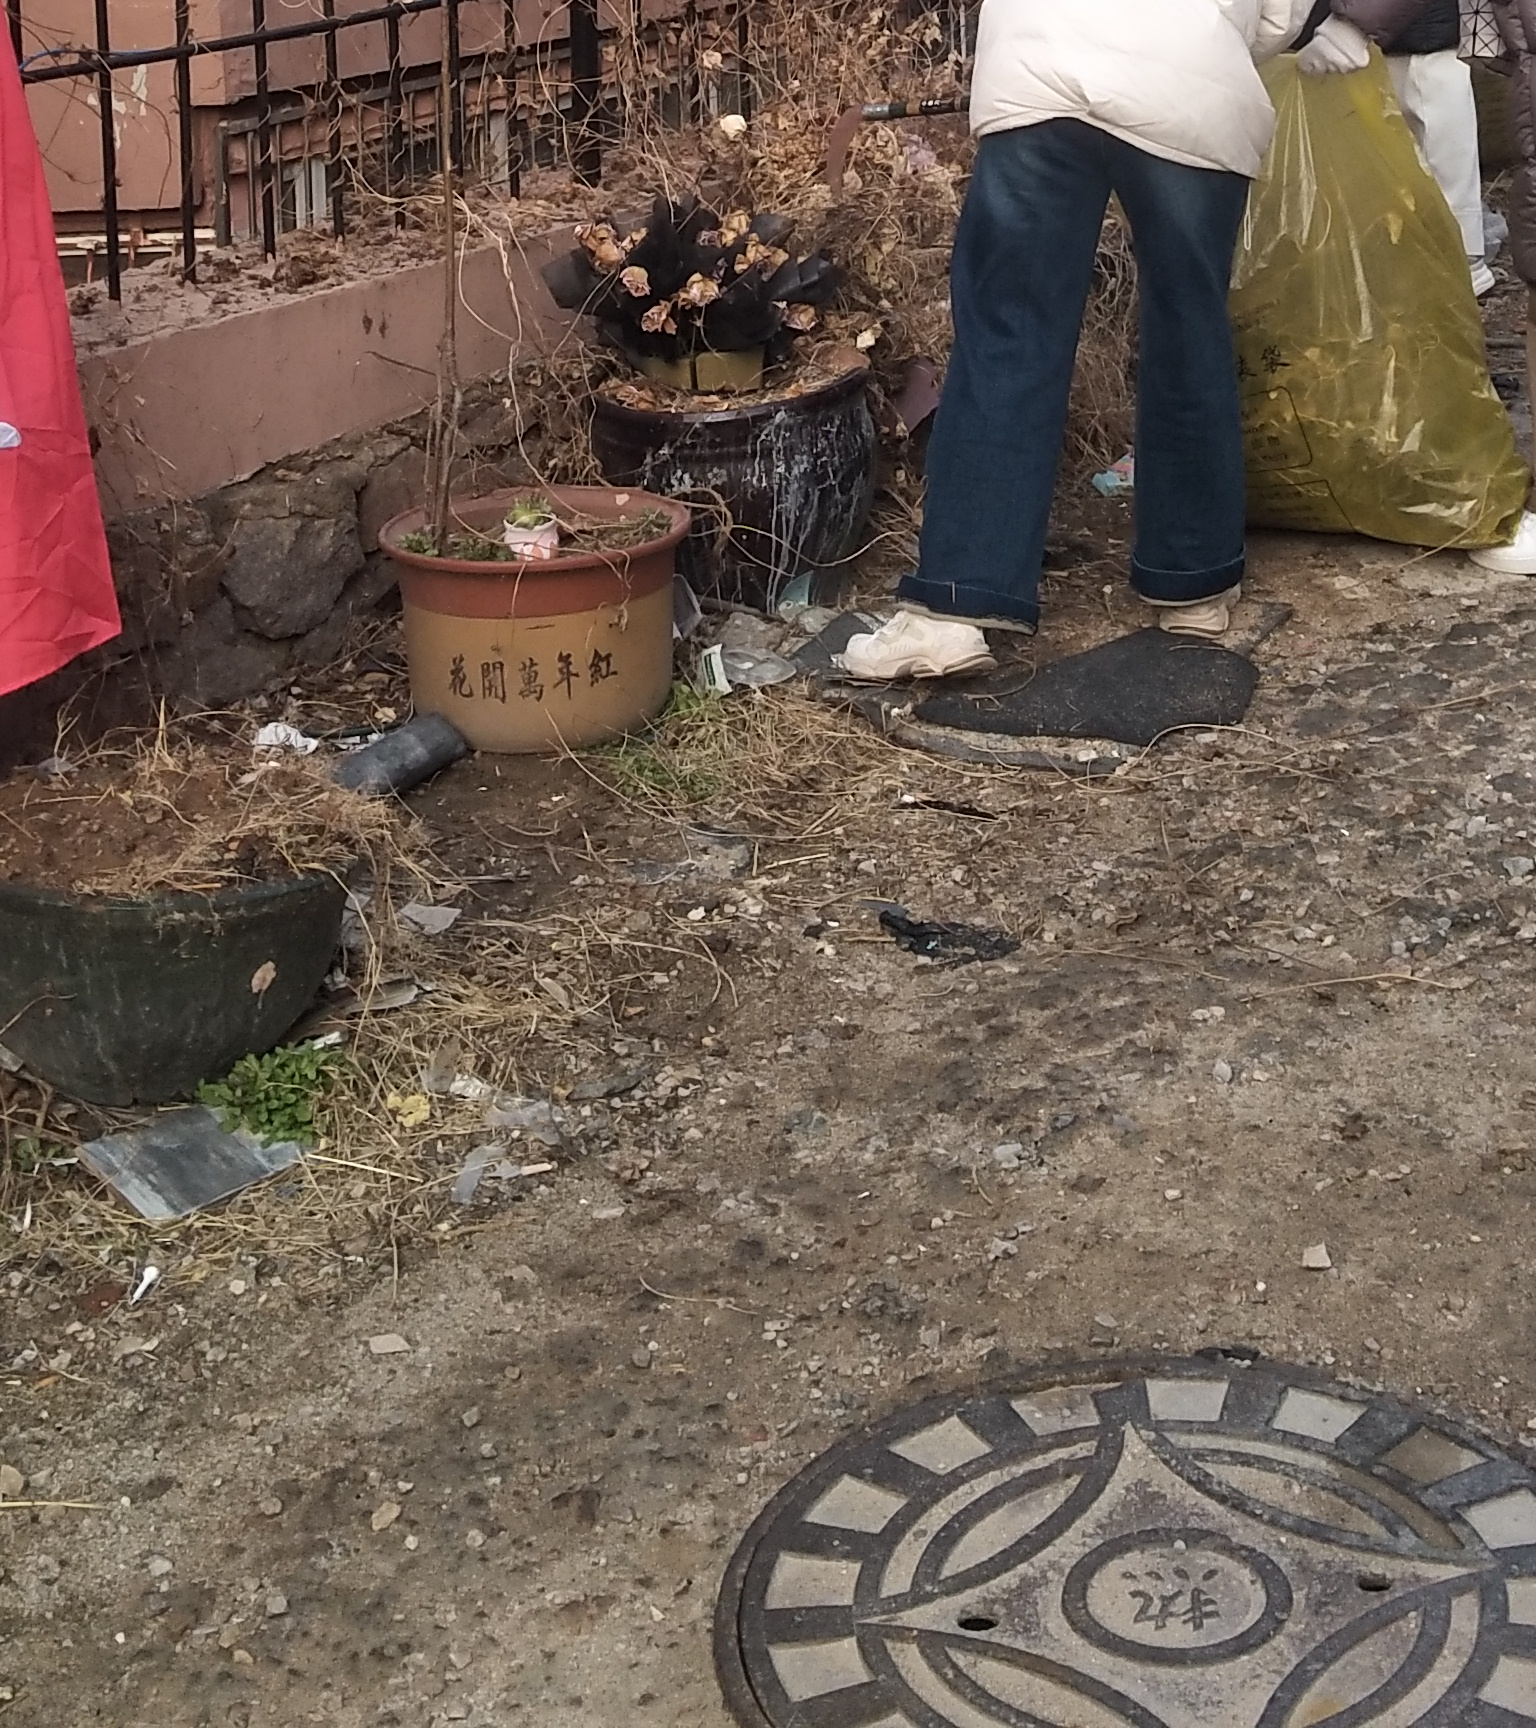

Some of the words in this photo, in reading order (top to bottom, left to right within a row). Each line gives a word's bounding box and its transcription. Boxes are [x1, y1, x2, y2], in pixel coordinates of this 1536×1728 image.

[448, 648, 618, 704] 花開萬年紅
